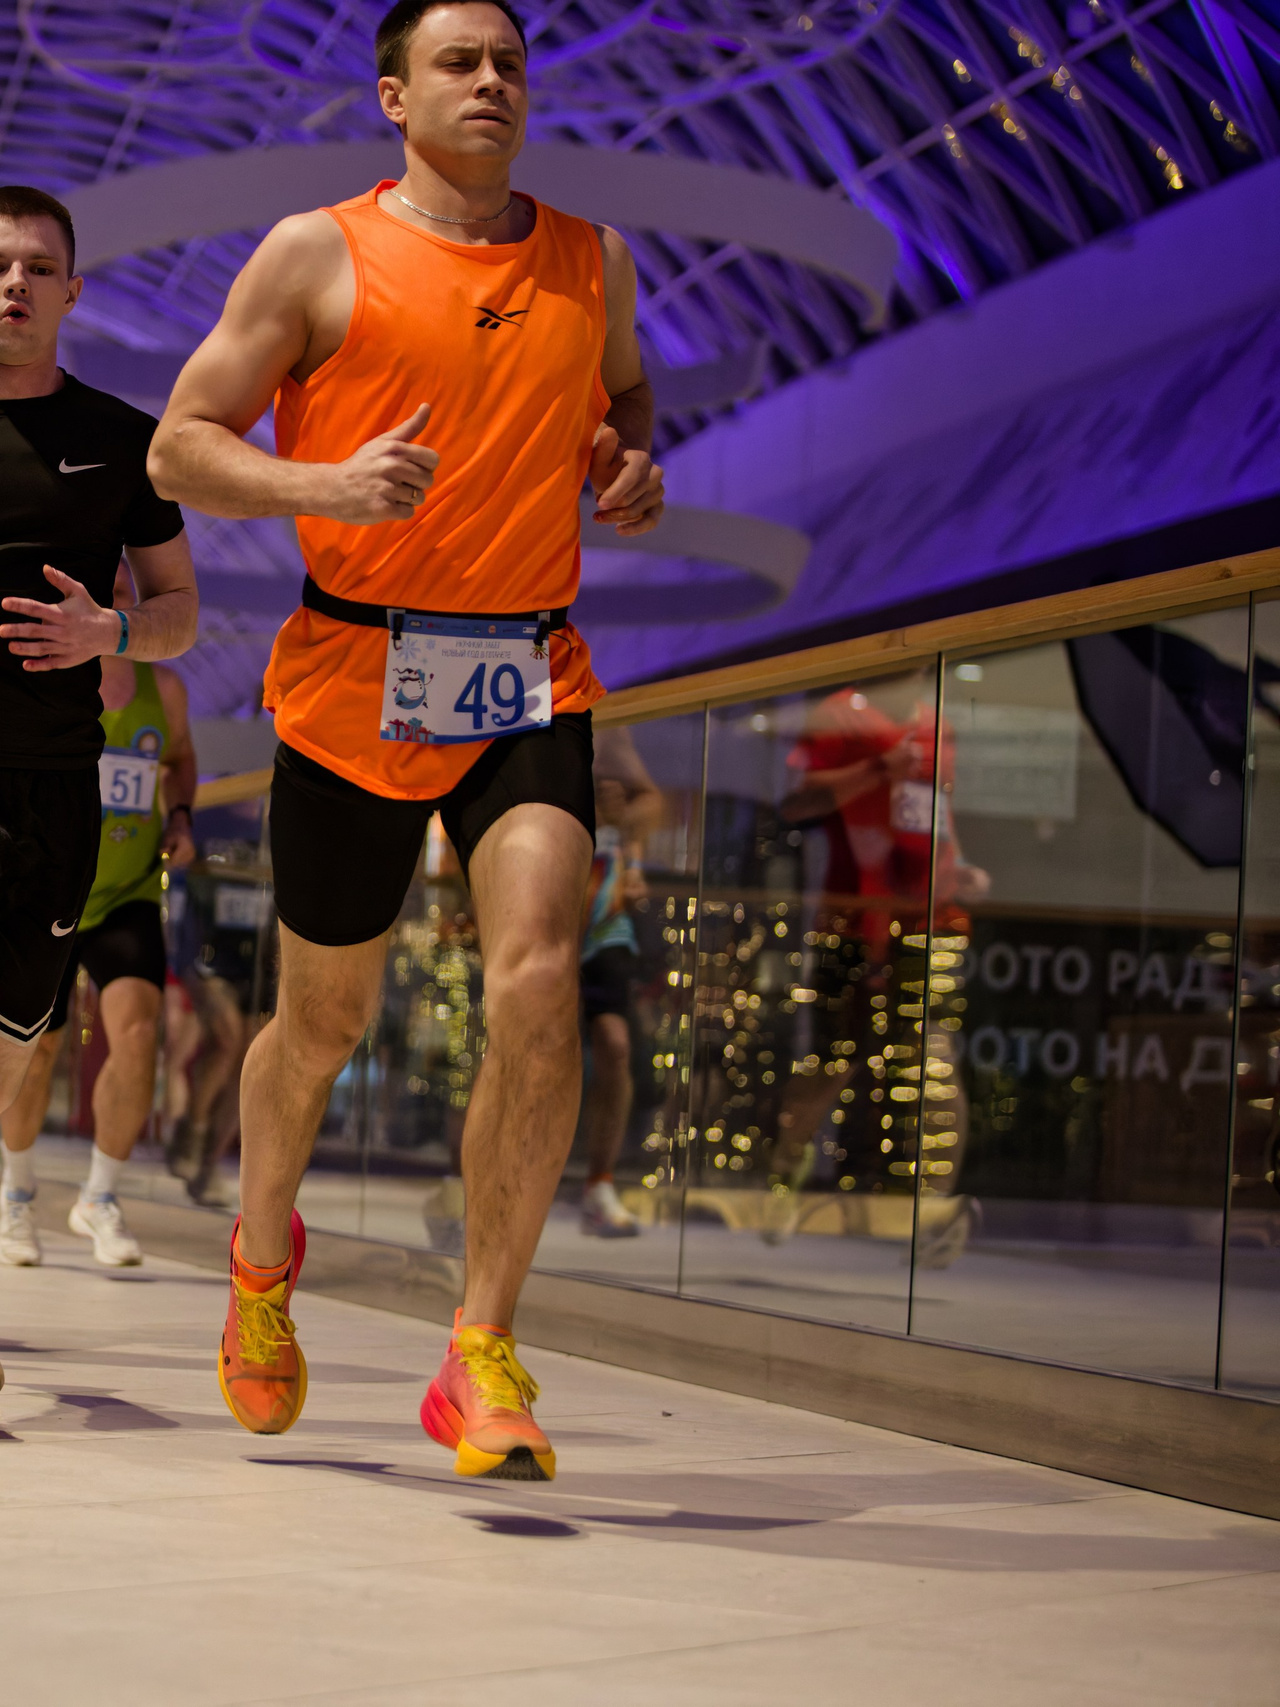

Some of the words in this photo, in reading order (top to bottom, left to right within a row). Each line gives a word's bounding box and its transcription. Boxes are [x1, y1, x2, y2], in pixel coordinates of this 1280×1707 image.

[453, 662, 526, 729] 49
[109, 768, 143, 806] 51
[1095, 1030, 1169, 1083] НА
